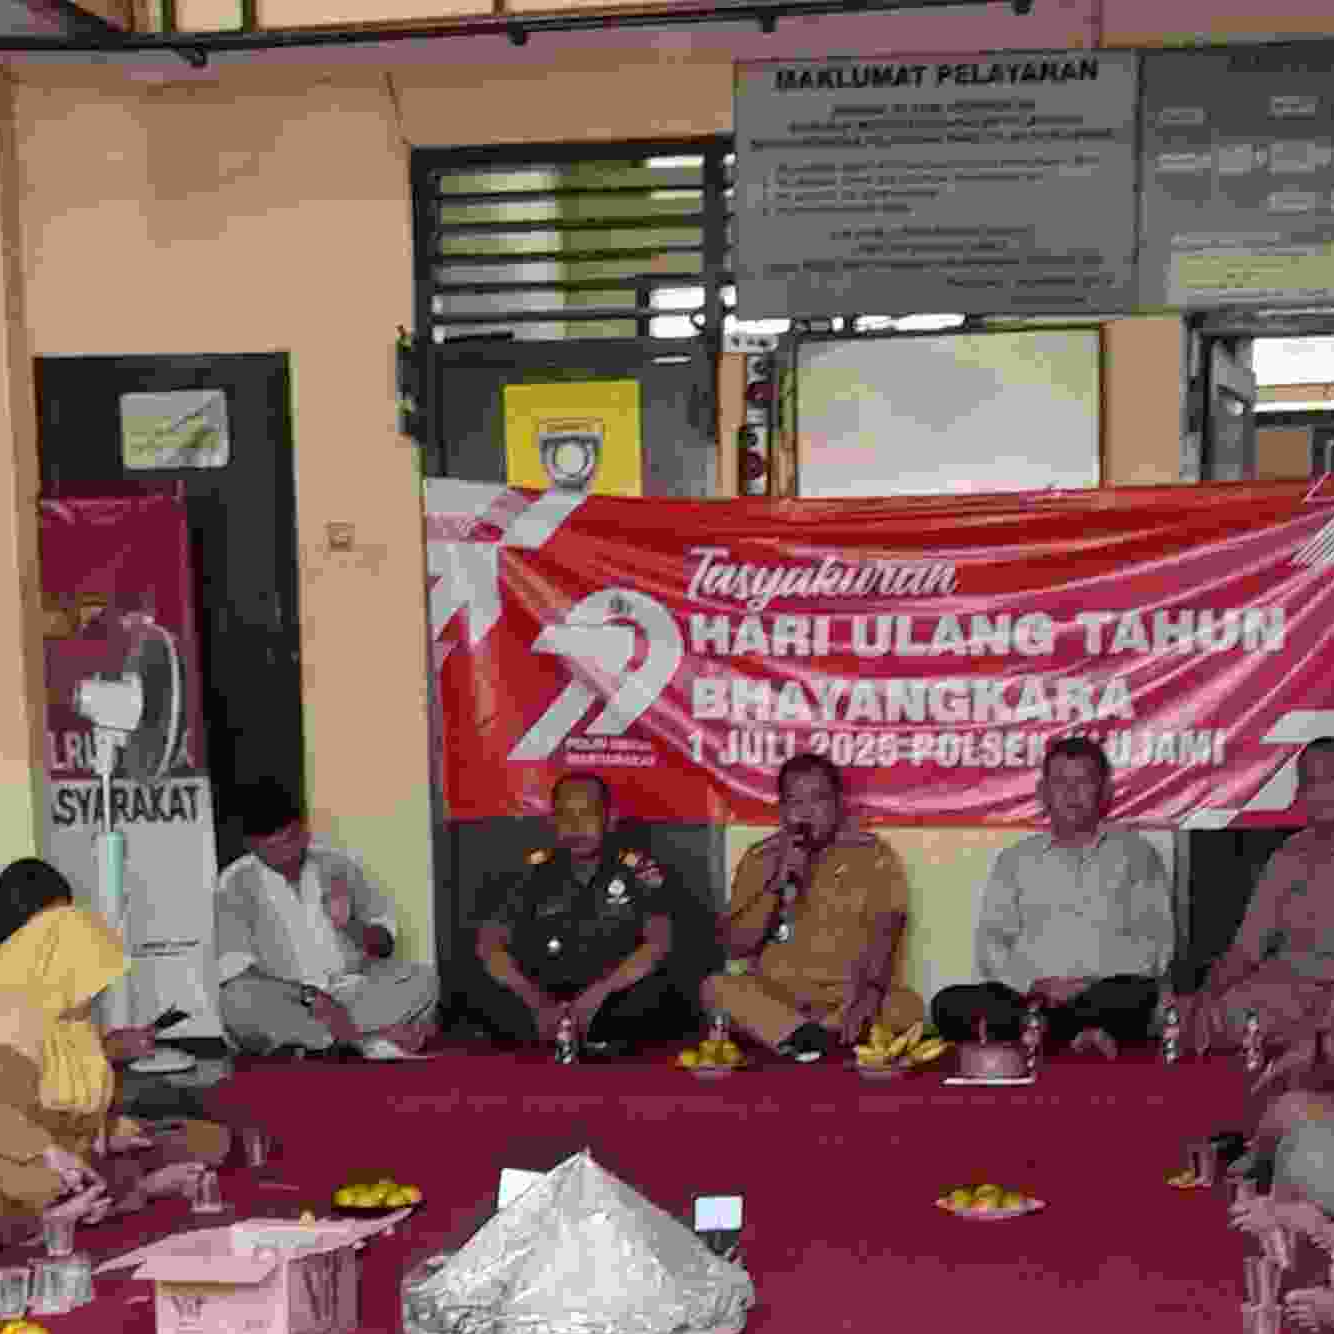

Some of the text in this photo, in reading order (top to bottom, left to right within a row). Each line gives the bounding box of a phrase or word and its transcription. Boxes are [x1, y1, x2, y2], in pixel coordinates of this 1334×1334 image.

[688, 606, 1285, 656] HARI ULANG TAHUN
[690, 677, 1136, 722] BHAYANGKARA
[717, 731, 796, 767] JULI
